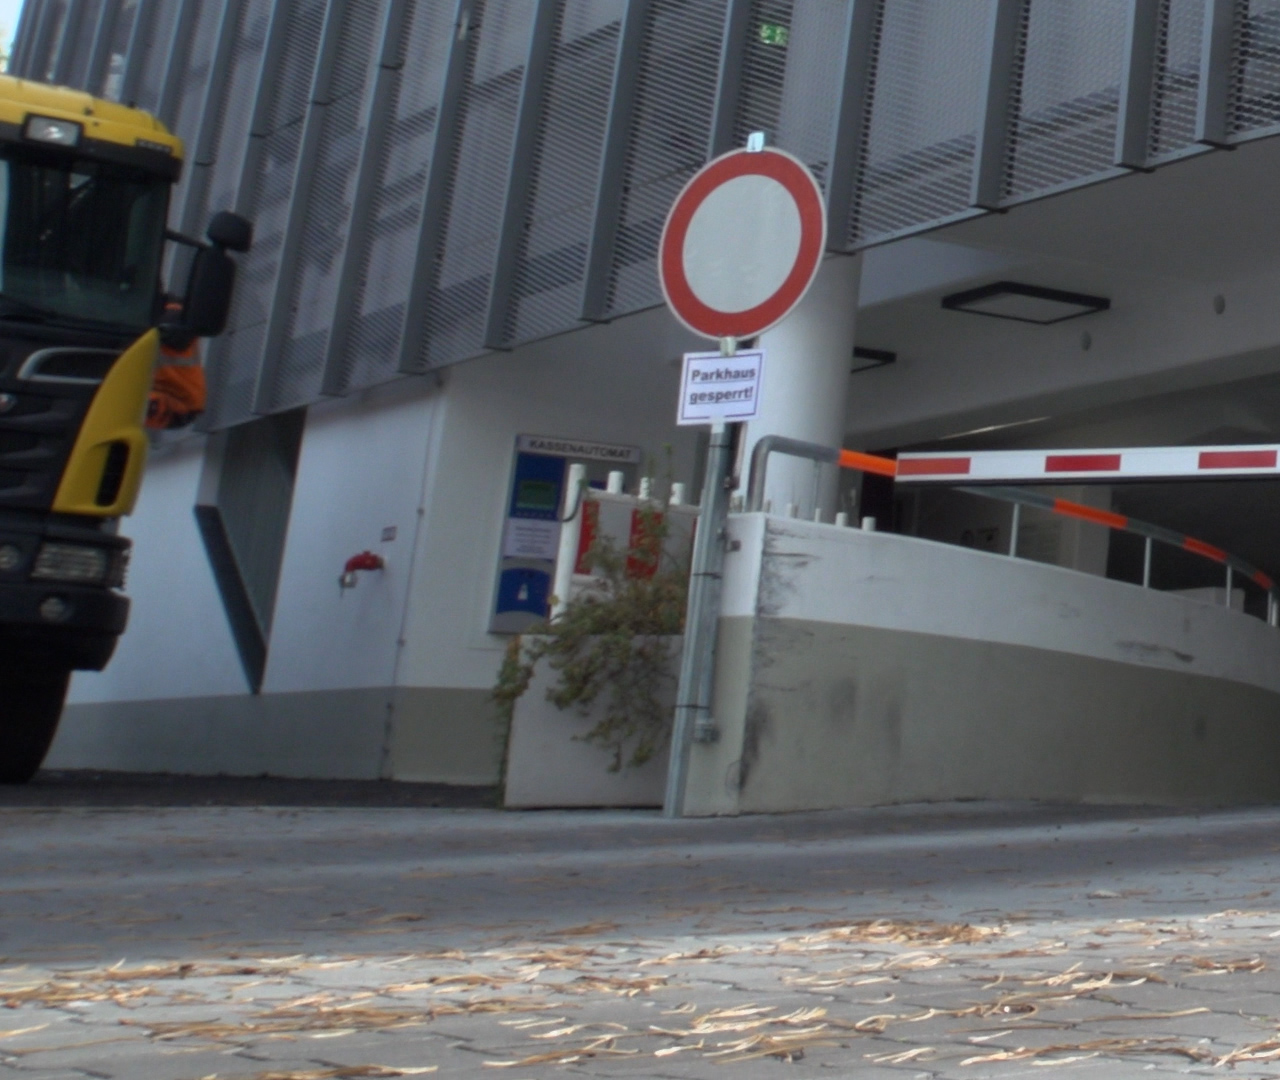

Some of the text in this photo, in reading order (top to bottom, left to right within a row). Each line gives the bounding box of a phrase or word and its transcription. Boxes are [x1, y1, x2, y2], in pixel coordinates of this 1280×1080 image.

[691, 367, 756, 382] Parkhaus
[689, 386, 754, 405] gesperrt!
[529, 439, 631, 459] KASSENAUTOMAT
